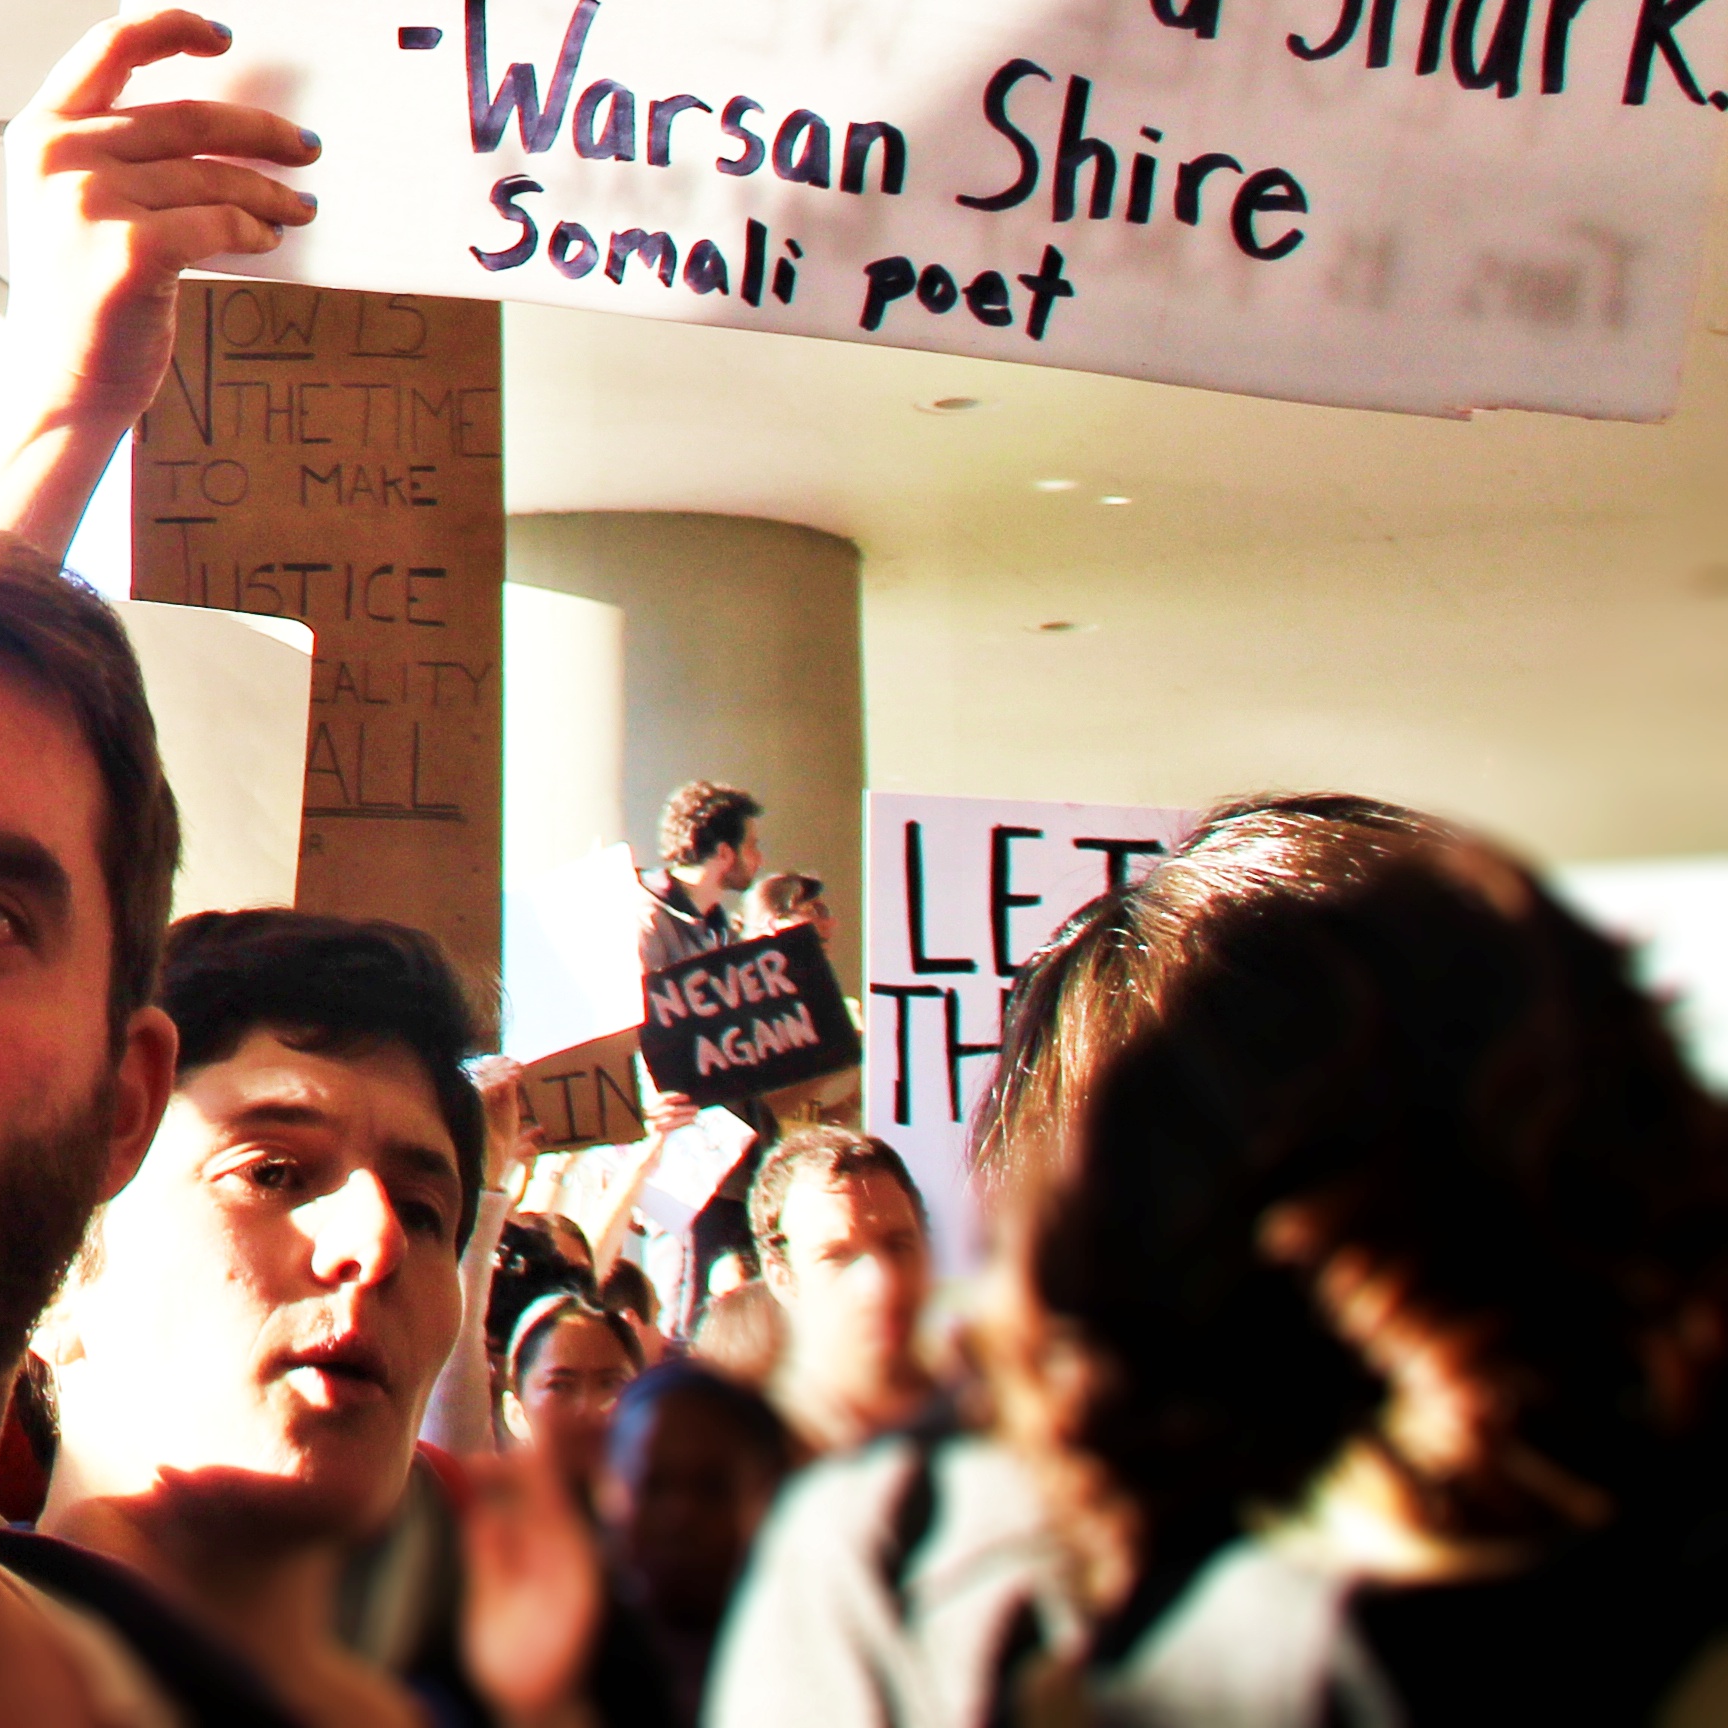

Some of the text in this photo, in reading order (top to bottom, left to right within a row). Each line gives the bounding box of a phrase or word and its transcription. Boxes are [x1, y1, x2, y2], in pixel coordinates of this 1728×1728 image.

[955, 57, 1310, 262] Shire
[468, 173, 1076, 341] Somali poet
[216, 381, 502, 460] THE TIME
[153, 458, 439, 508] TO MAKE
[153, 516, 449, 628] JUSTICE
[903, 819, 1172, 978] LET
[648, 949, 799, 1029] NEVER
[696, 1001, 821, 1076] AGAIN
